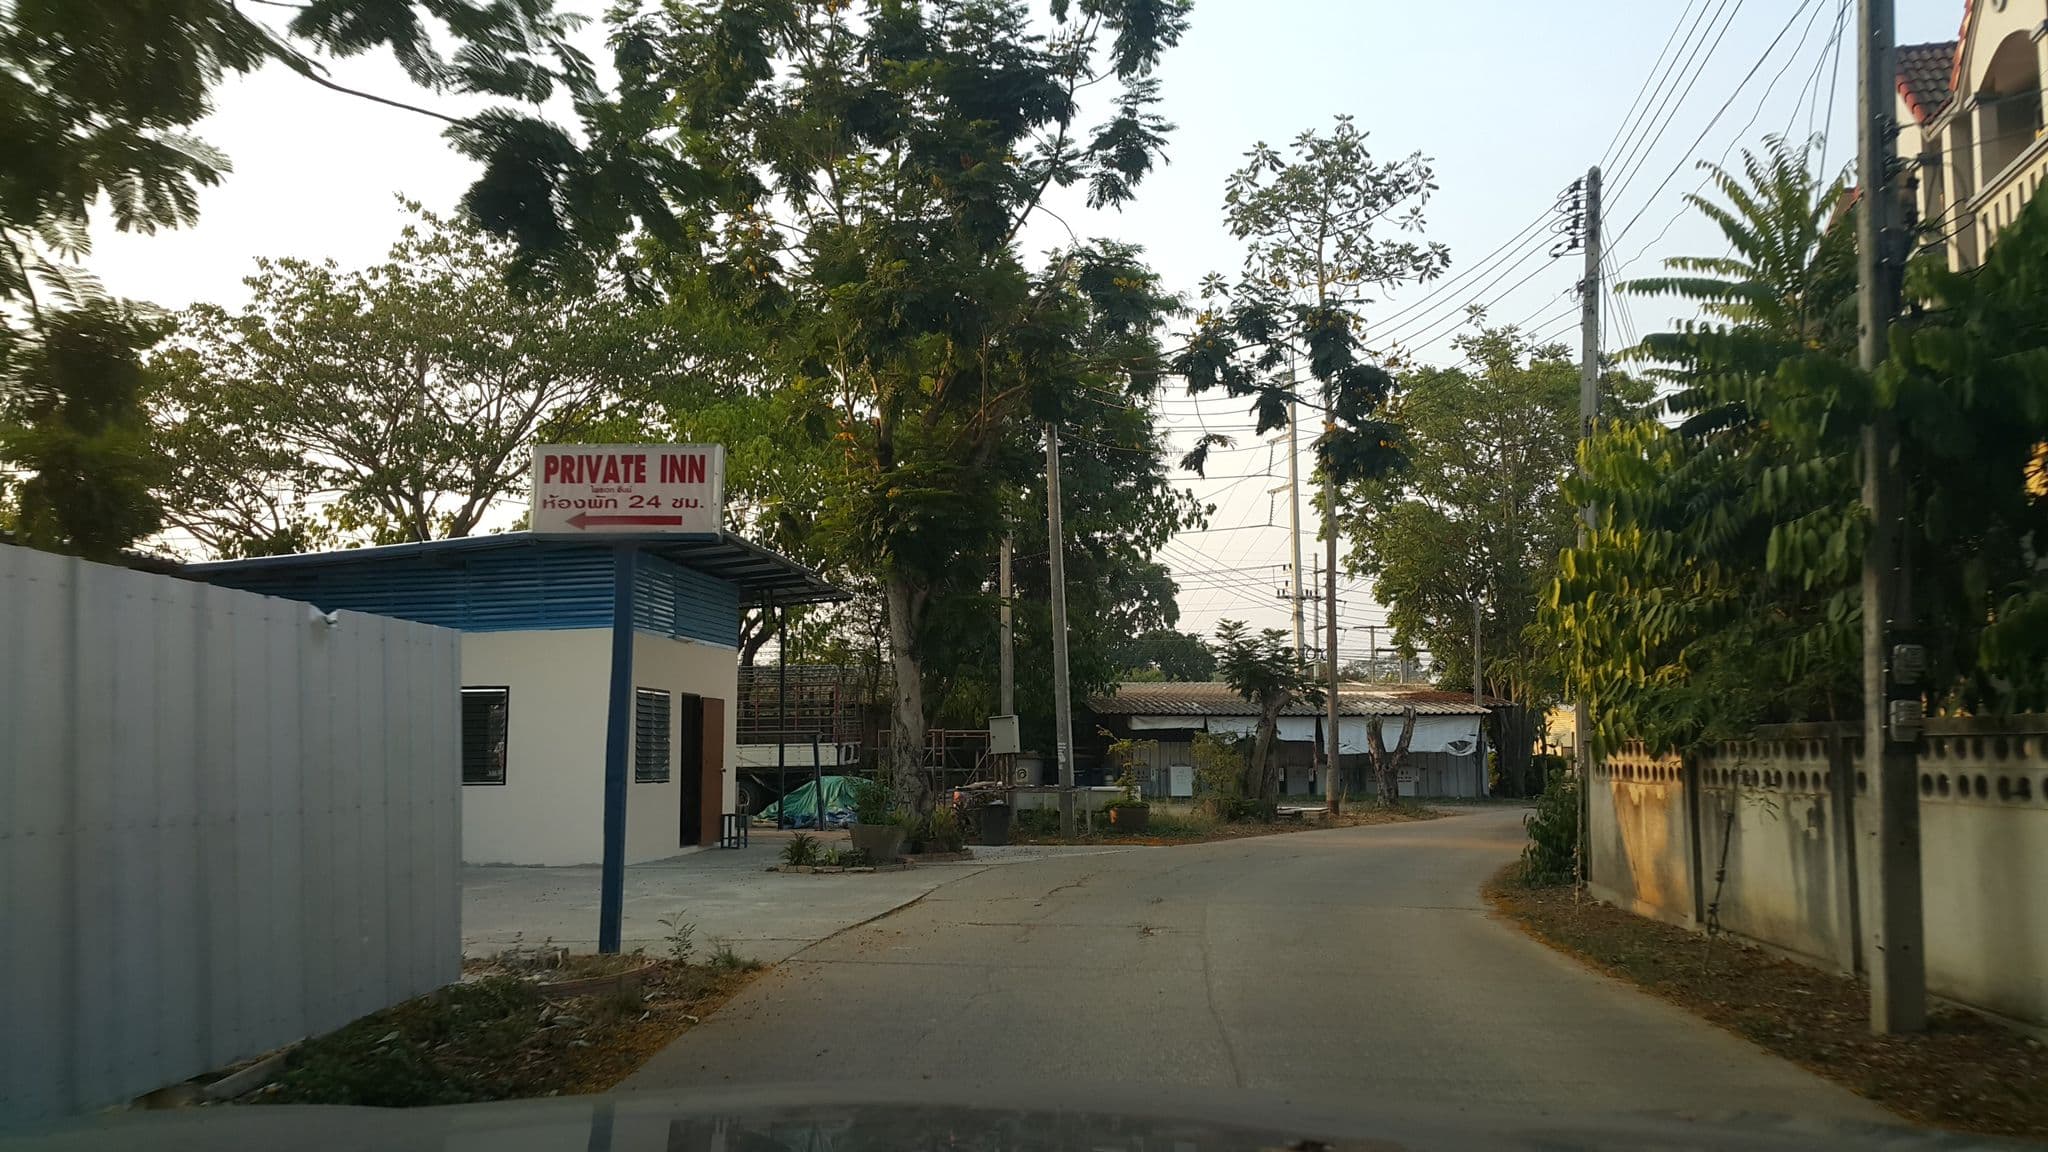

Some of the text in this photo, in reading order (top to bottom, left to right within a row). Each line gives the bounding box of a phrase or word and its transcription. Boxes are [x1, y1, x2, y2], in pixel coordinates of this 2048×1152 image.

[544, 454, 706, 484] PRIVATE INN
[542, 493, 705, 510] ห้องพัก 24 ชม.
